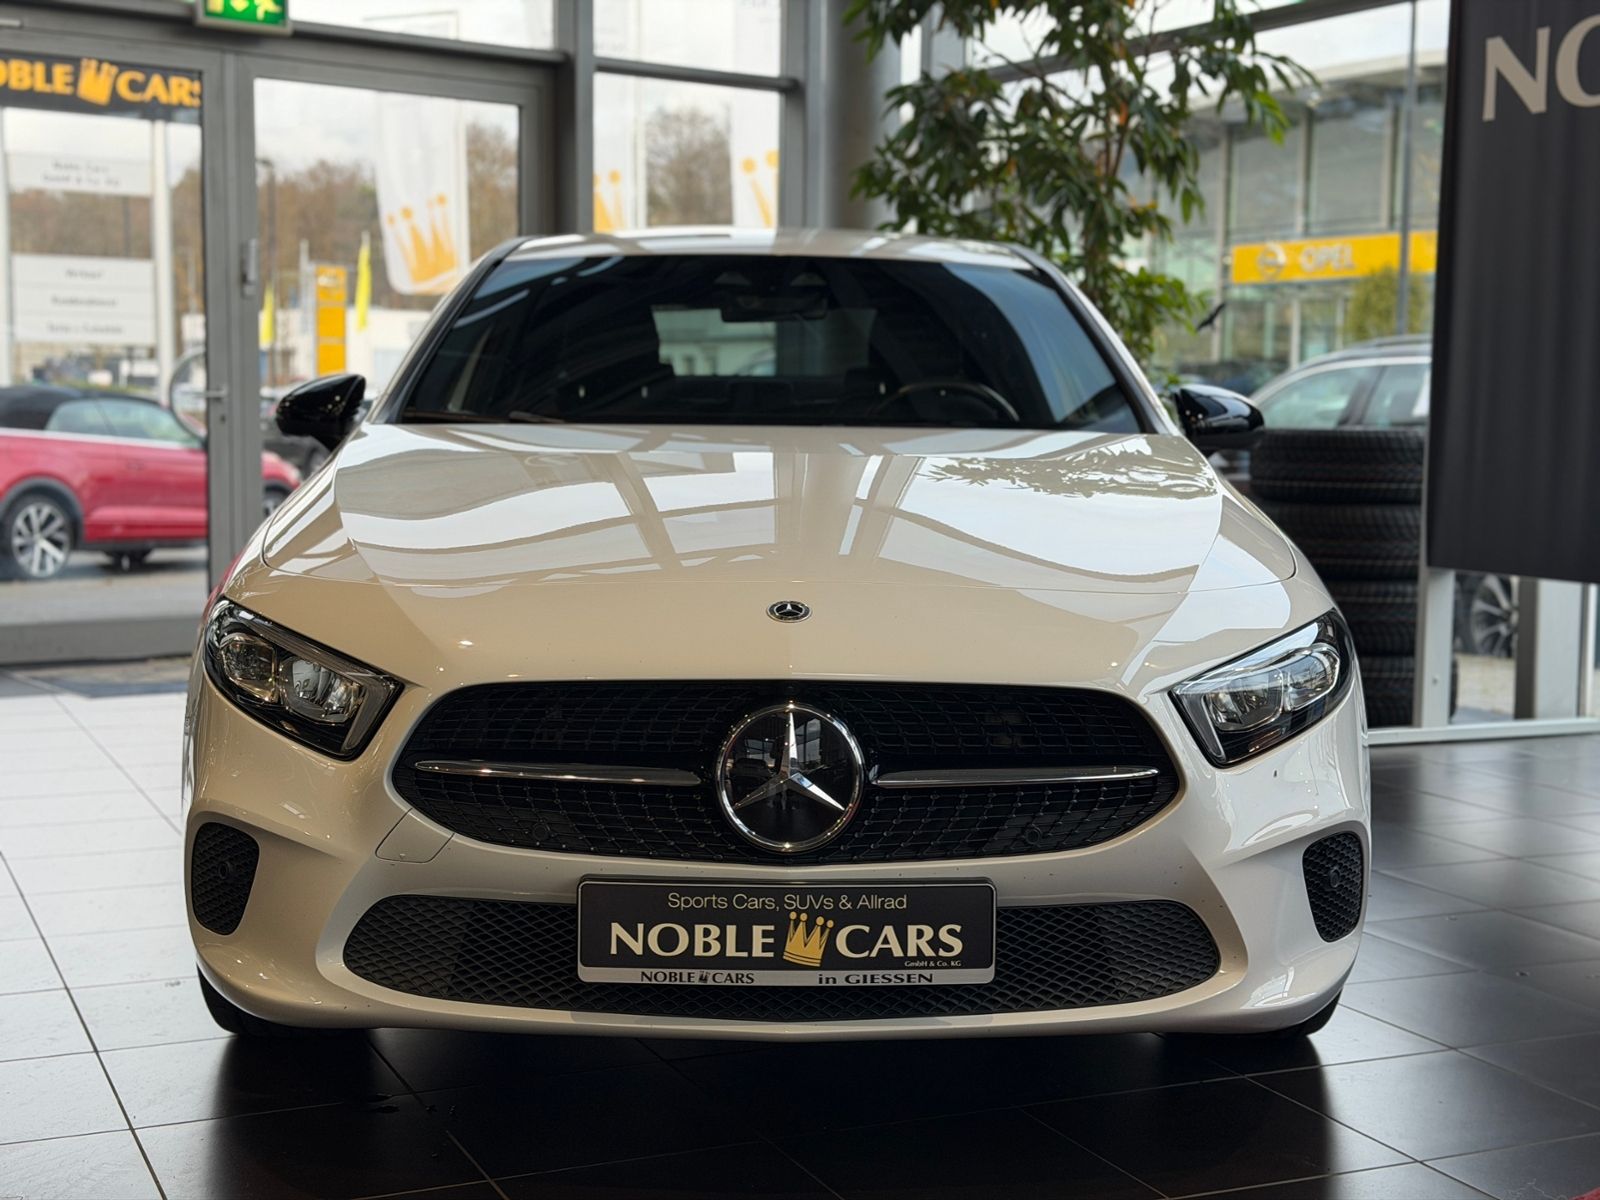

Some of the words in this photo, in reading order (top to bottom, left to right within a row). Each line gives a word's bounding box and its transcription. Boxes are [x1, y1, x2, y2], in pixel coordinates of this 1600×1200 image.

[0, 58, 75, 95] BLE
[1300, 243, 1356, 273] OPEL
[667, 892, 728, 911] Sports
[732, 893, 780, 912] Cars,
[783, 894, 834, 910] SUVs
[838, 894, 853, 910] &
[856, 894, 908, 910] Allrad
[610, 922, 775, 958] NOBLE
[835, 924, 964, 959] CARS
[640, 970, 695, 984] NOBLE
[712, 970, 755, 984] CARS
[818, 973, 837, 985] in
[844, 973, 934, 985] GIESSEN
